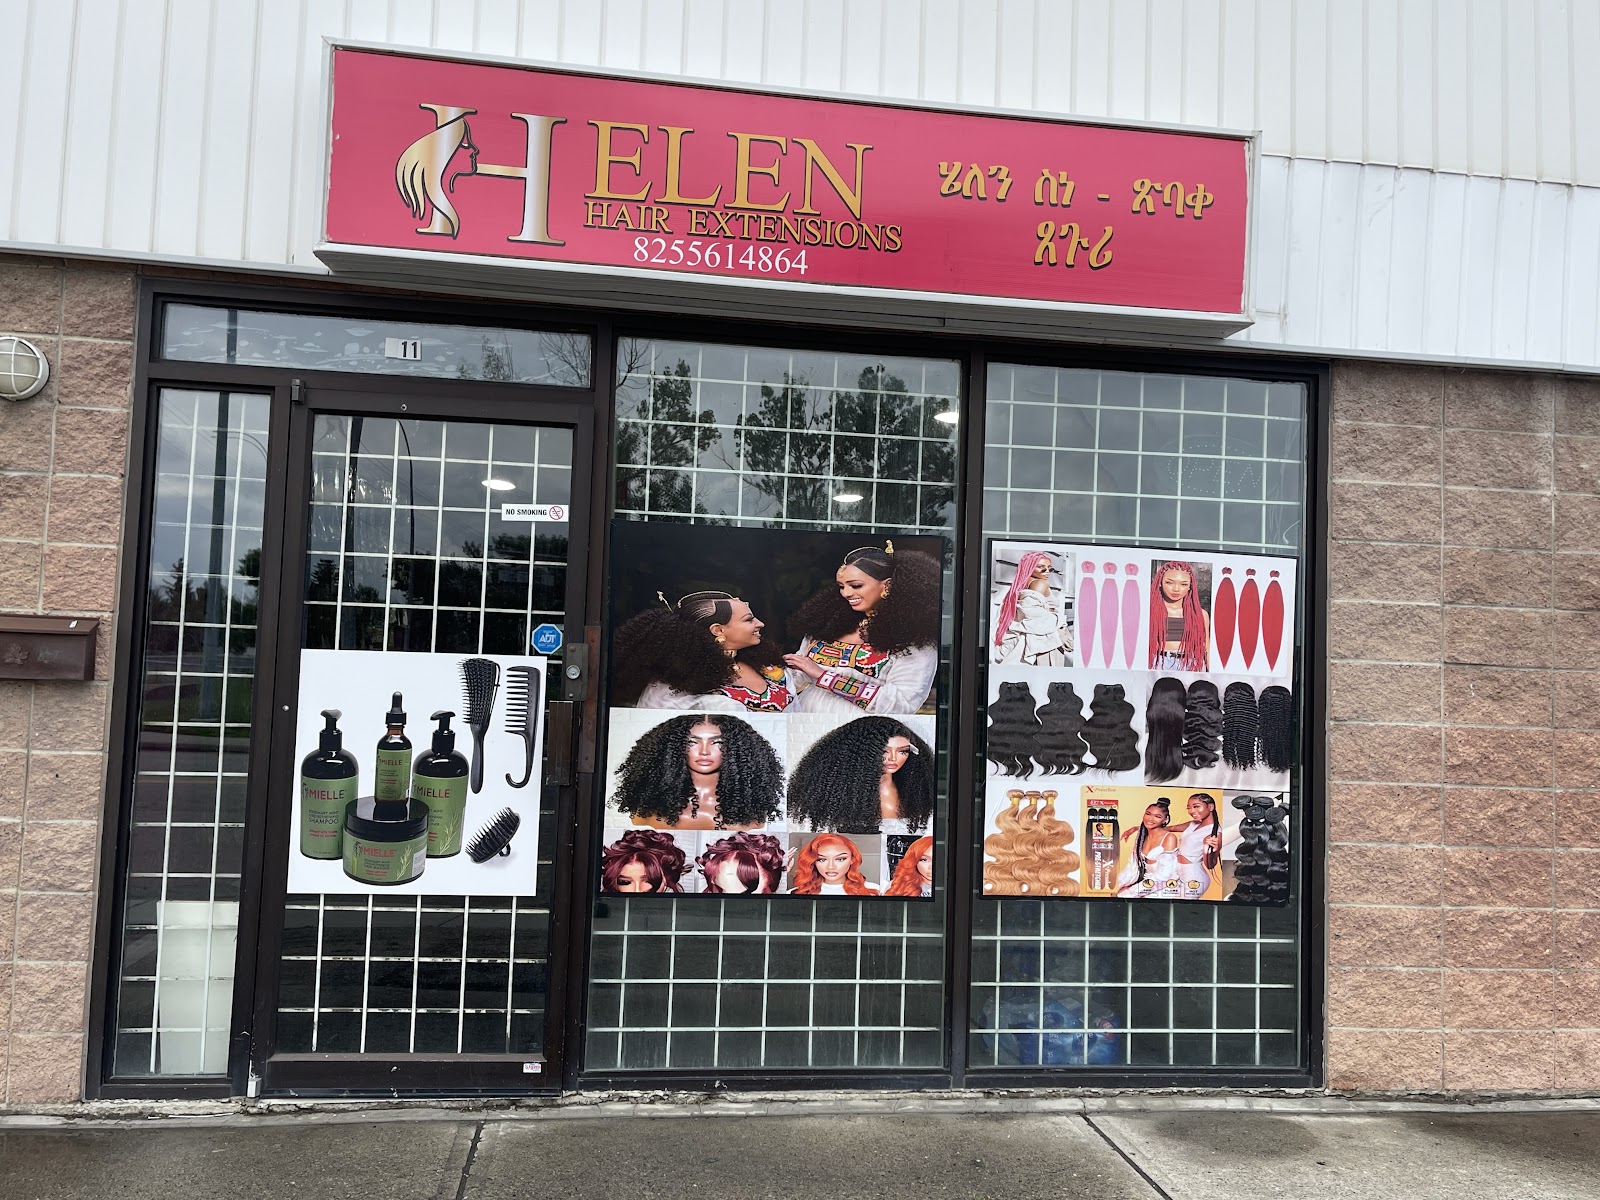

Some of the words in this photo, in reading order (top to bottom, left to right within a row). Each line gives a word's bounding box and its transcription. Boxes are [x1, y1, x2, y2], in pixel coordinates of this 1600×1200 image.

[395, 102, 874, 247] HELEN
[583, 200, 673, 234] HAIR
[689, 210, 903, 252] EXTENSIONS
[633, 236, 808, 275] 8255614864
[401, 340, 418, 359] 11
[505, 508, 515, 516] NO
[539, 634, 557, 644] ADT
[309, 789, 345, 800] MIELLE
[416, 786, 451, 798] MIELLE
[363, 847, 396, 858] MIELLE
